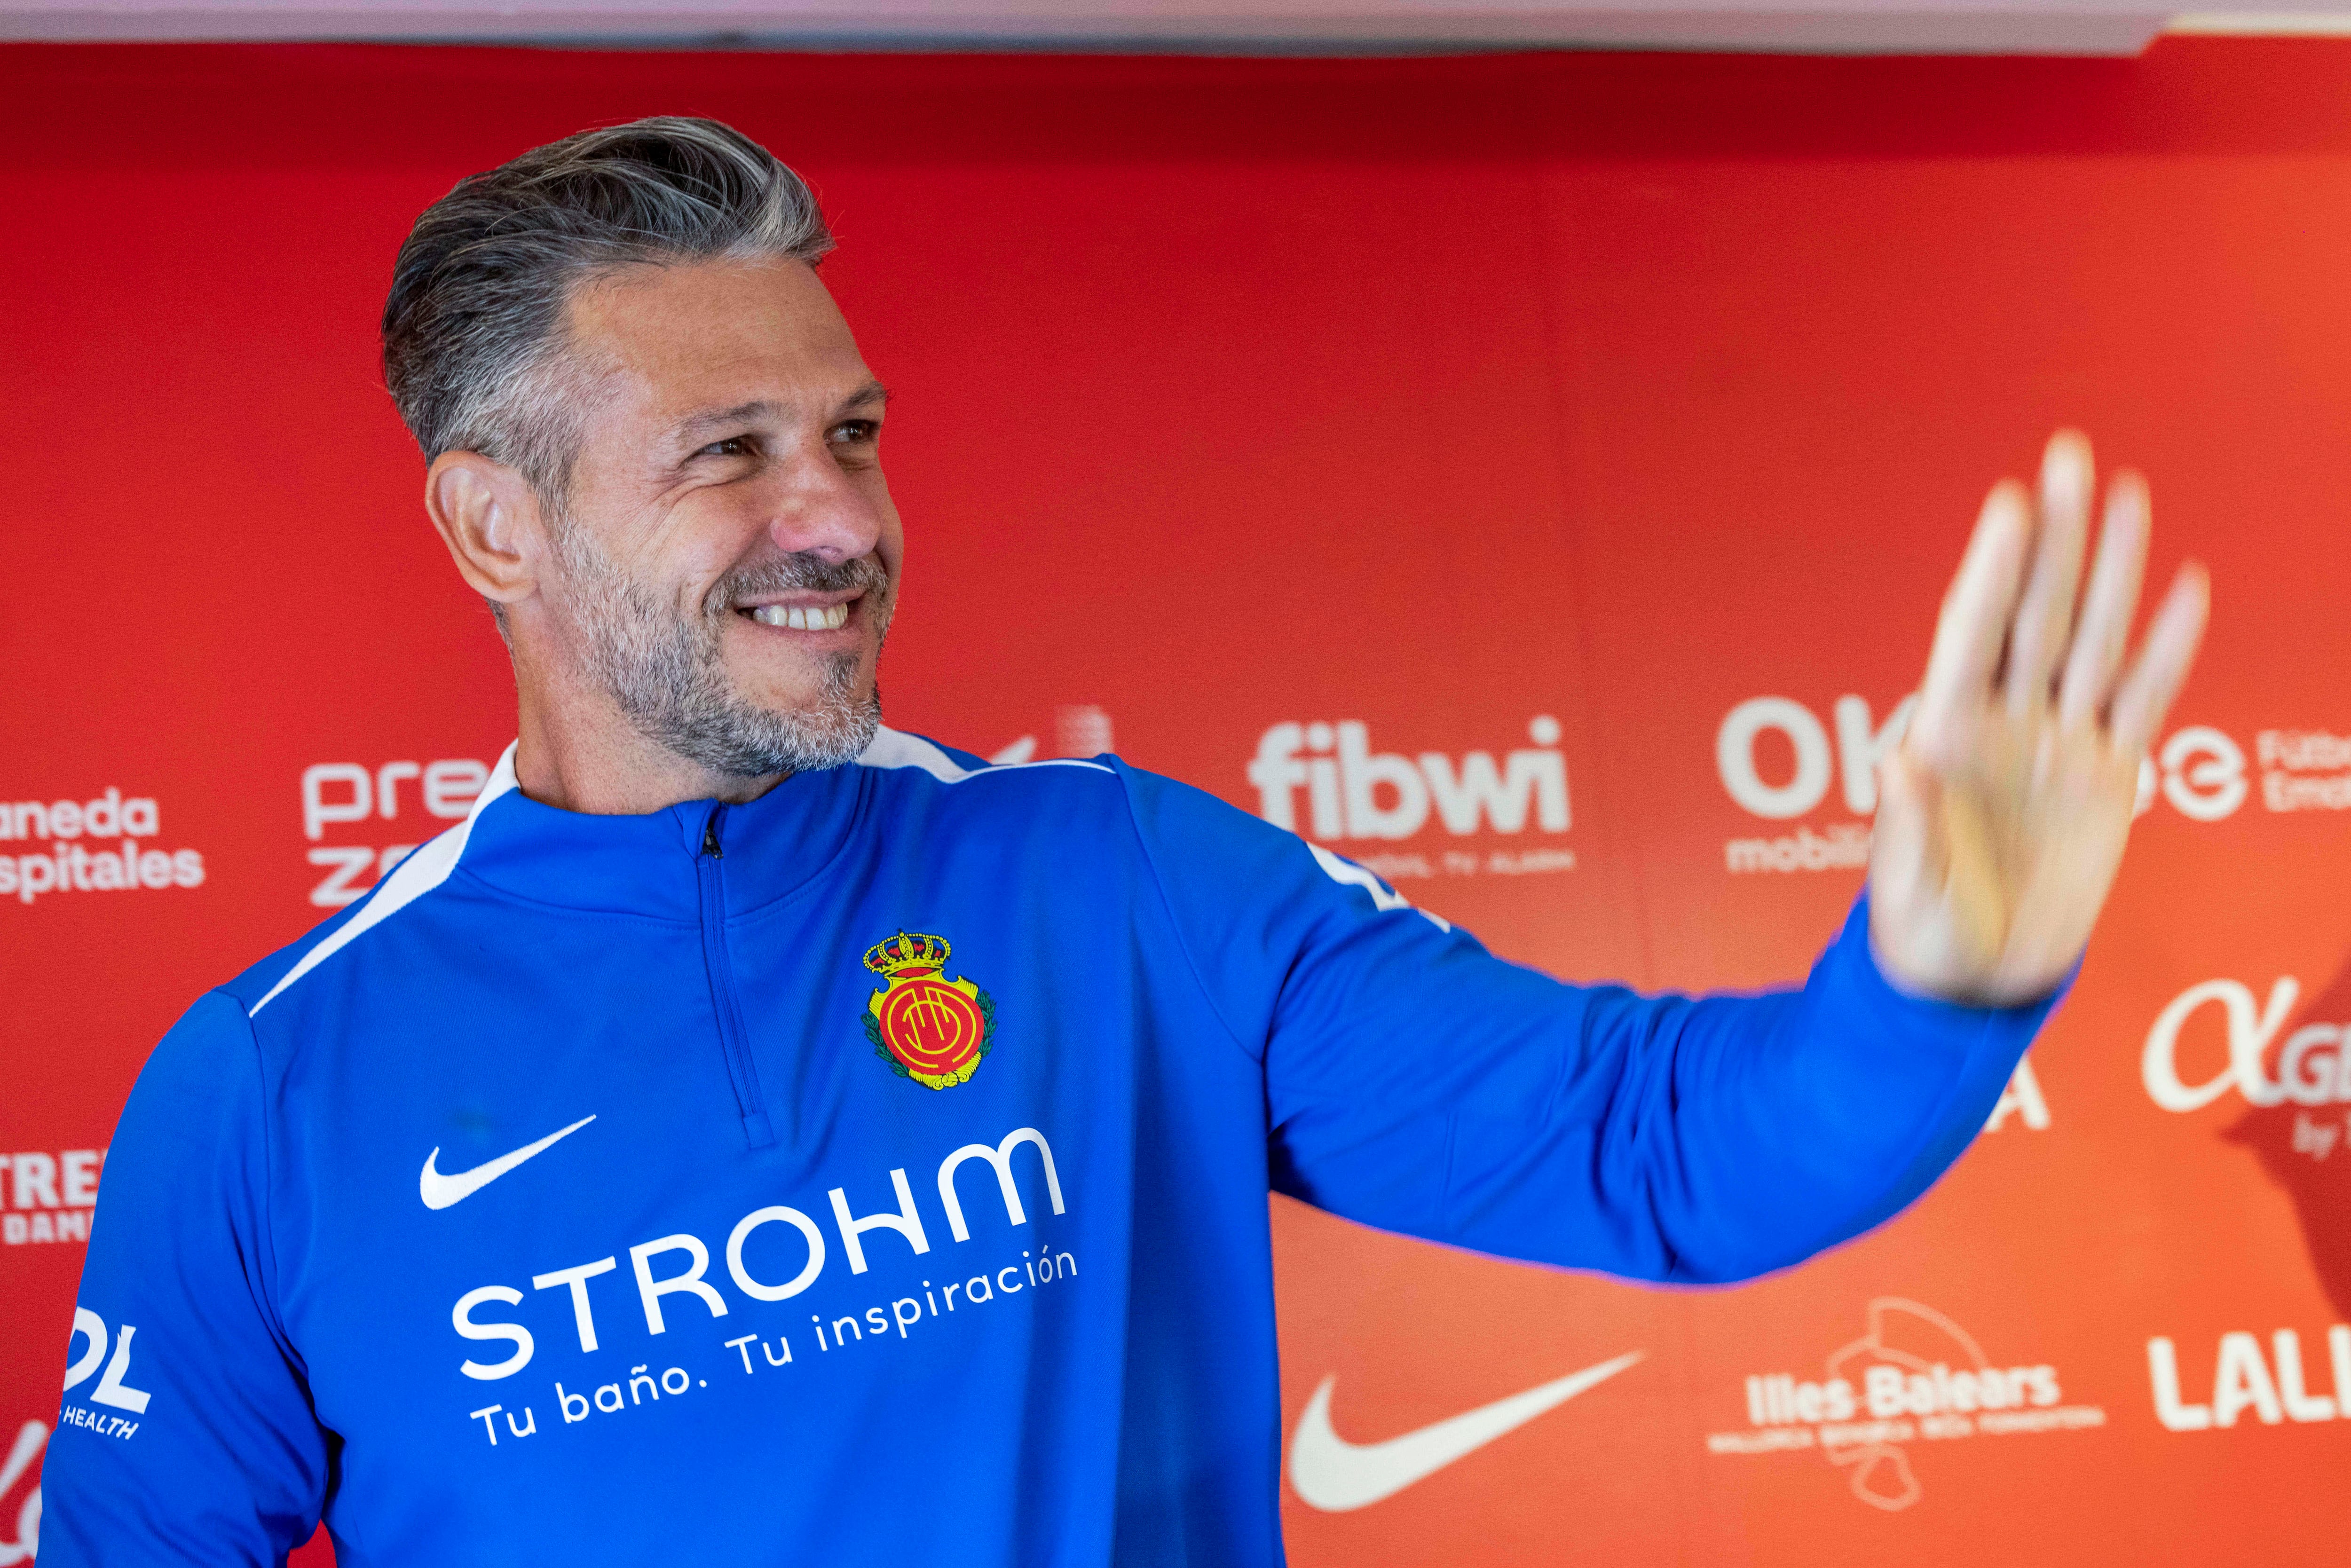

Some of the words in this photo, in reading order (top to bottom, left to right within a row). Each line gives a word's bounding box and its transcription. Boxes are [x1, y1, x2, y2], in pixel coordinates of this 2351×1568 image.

[302, 759, 488, 840] pre
[1247, 715, 1572, 840] fibwi
[3, 1212, 94, 1245] DAM
[452, 1127, 1066, 1380] STROHM
[470, 1403, 537, 1446] Tu
[555, 1364, 707, 1424] baño.
[725, 1334, 793, 1375] Tu
[812, 1245, 1078, 1339] inspiración
[63, 1405, 139, 1440] HEALTH
[1746, 1373, 1856, 1425] Illes
[1865, 1362, 2061, 1418] Balears
